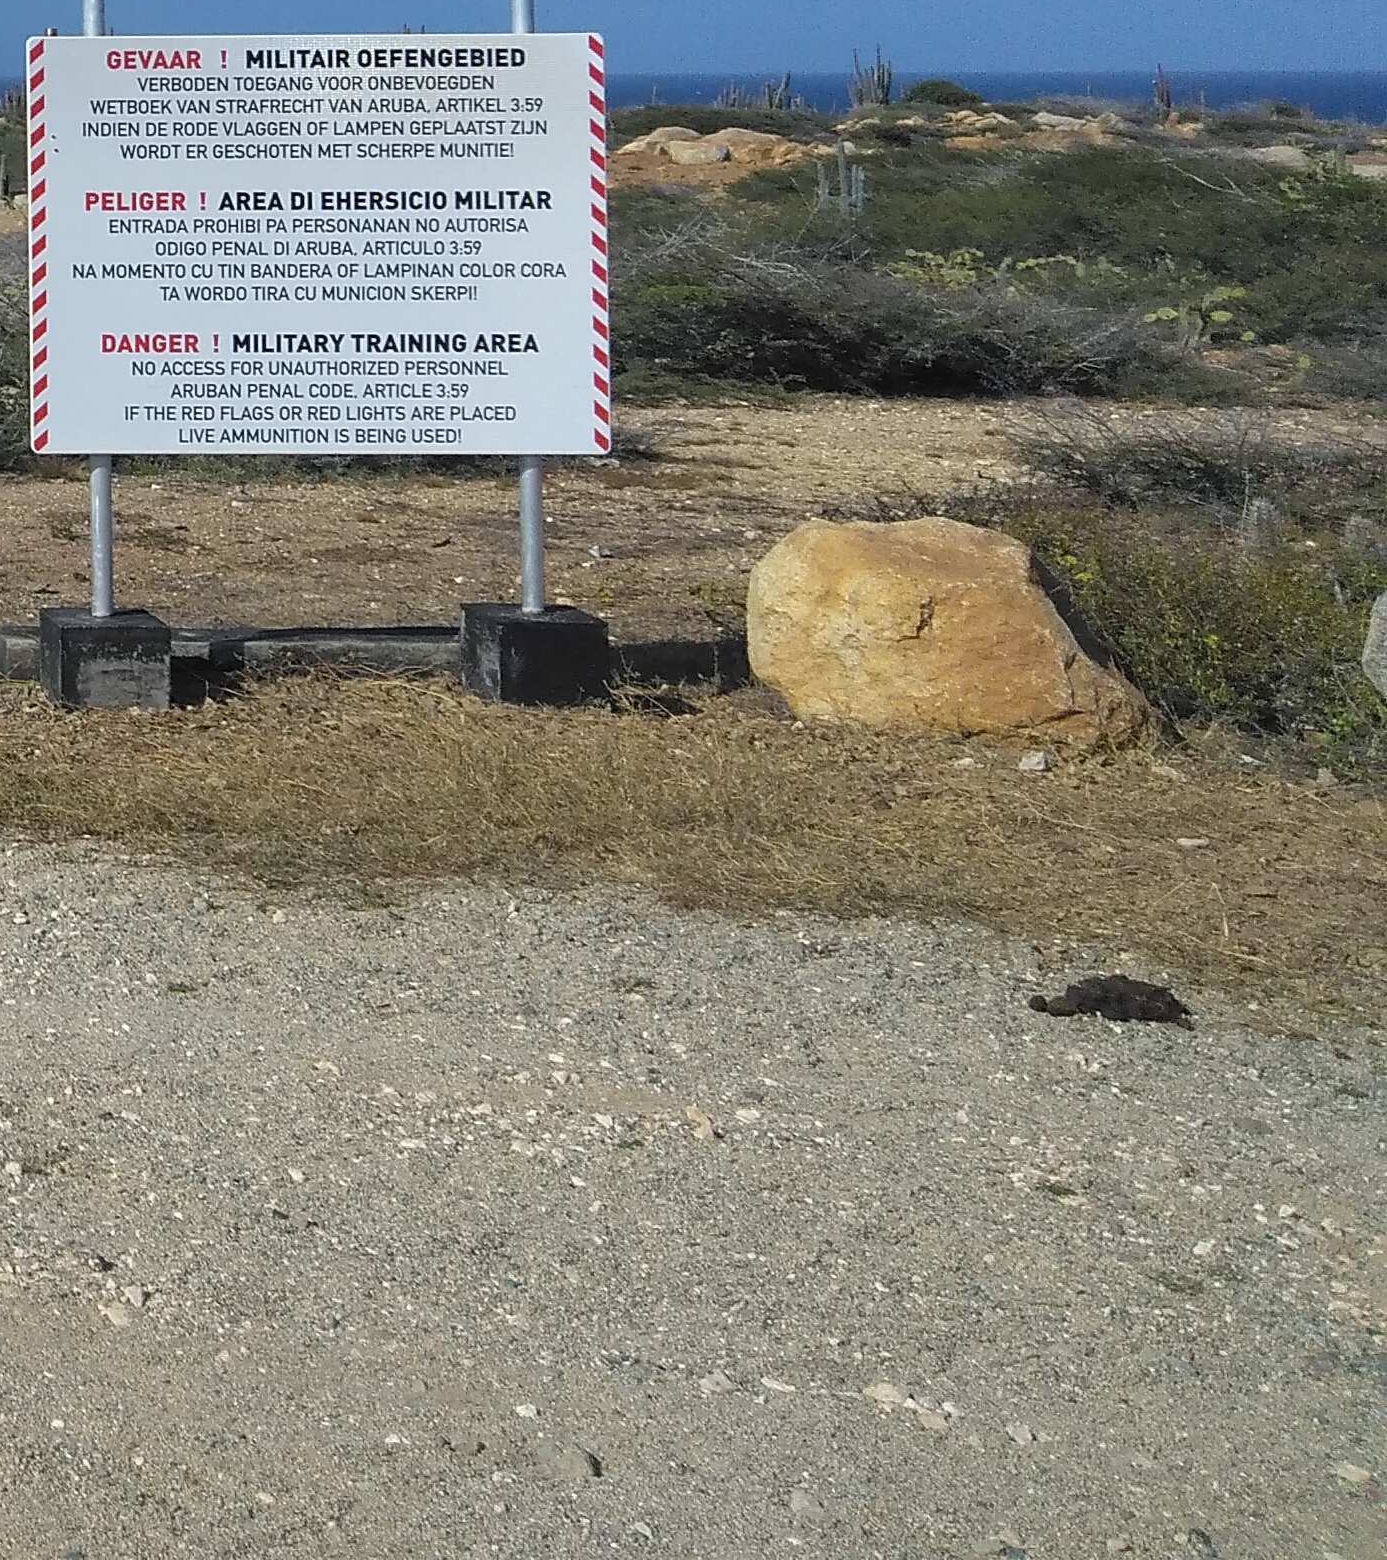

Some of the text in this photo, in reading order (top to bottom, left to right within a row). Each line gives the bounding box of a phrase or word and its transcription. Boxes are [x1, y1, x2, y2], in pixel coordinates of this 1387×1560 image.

[106, 48, 526, 69] GEVAAR ! MILITAIR OEFENGEBIED
[136, 76, 495, 92] VERBODEN TOEGANG VOOR ONBEVOEGDEN
[89, 100, 173, 114] WETBOEK
[176, 100, 211, 114] VAN
[215, 99, 325, 114] STRAFRECHT
[327, 99, 363, 113] VAN
[435, 98, 507, 112] ARTIKEL
[510, 98, 544, 112] 3:59
[82, 120, 548, 137] INDIEN DE RODE VLAGGEN OF LAMPEN GEPLAATST ZIJN
[119, 143, 515, 159] WORDT ER GESCHOTEN MET SCHERPE MUNITIE!
[85, 191, 553, 211] PELIGER ! AREA DI EHERSICIO MILITAR
[108, 218, 530, 233] ENTRADA PROHIBI PA PERSONANAN NO AUTORISA
[154, 242, 207, 256] ODIGO
[211, 241, 269, 256] PENAL
[273, 241, 290, 255] DI
[361, 241, 445, 255] ARTICULO
[449, 241, 482, 255] 3:59
[72, 263, 567, 278] NA MOMENTO CU TIN BANDERA OF LAMPINAN COLOR CORA
[159, 286, 478, 301] TA WORDO TIRA CU MUNICION SKERPI!
[101, 334, 540, 353] DANGER ! MILITARY TRAINING AREA
[131, 361, 509, 375] NO ACCESS FOR UNAUTHORIZED PERSONNEL
[170, 384, 242, 398] ARUBAN
[246, 384, 305, 398] PENAL
[362, 384, 433, 398] ARTICLE
[436, 384, 469, 398] 3:59
[124, 406, 517, 421] IF THE RED FLAGS OR RED LIGHTS ARE PLACED
[178, 429, 462, 443] LIVE AMMUNITION IS BEING USED!
